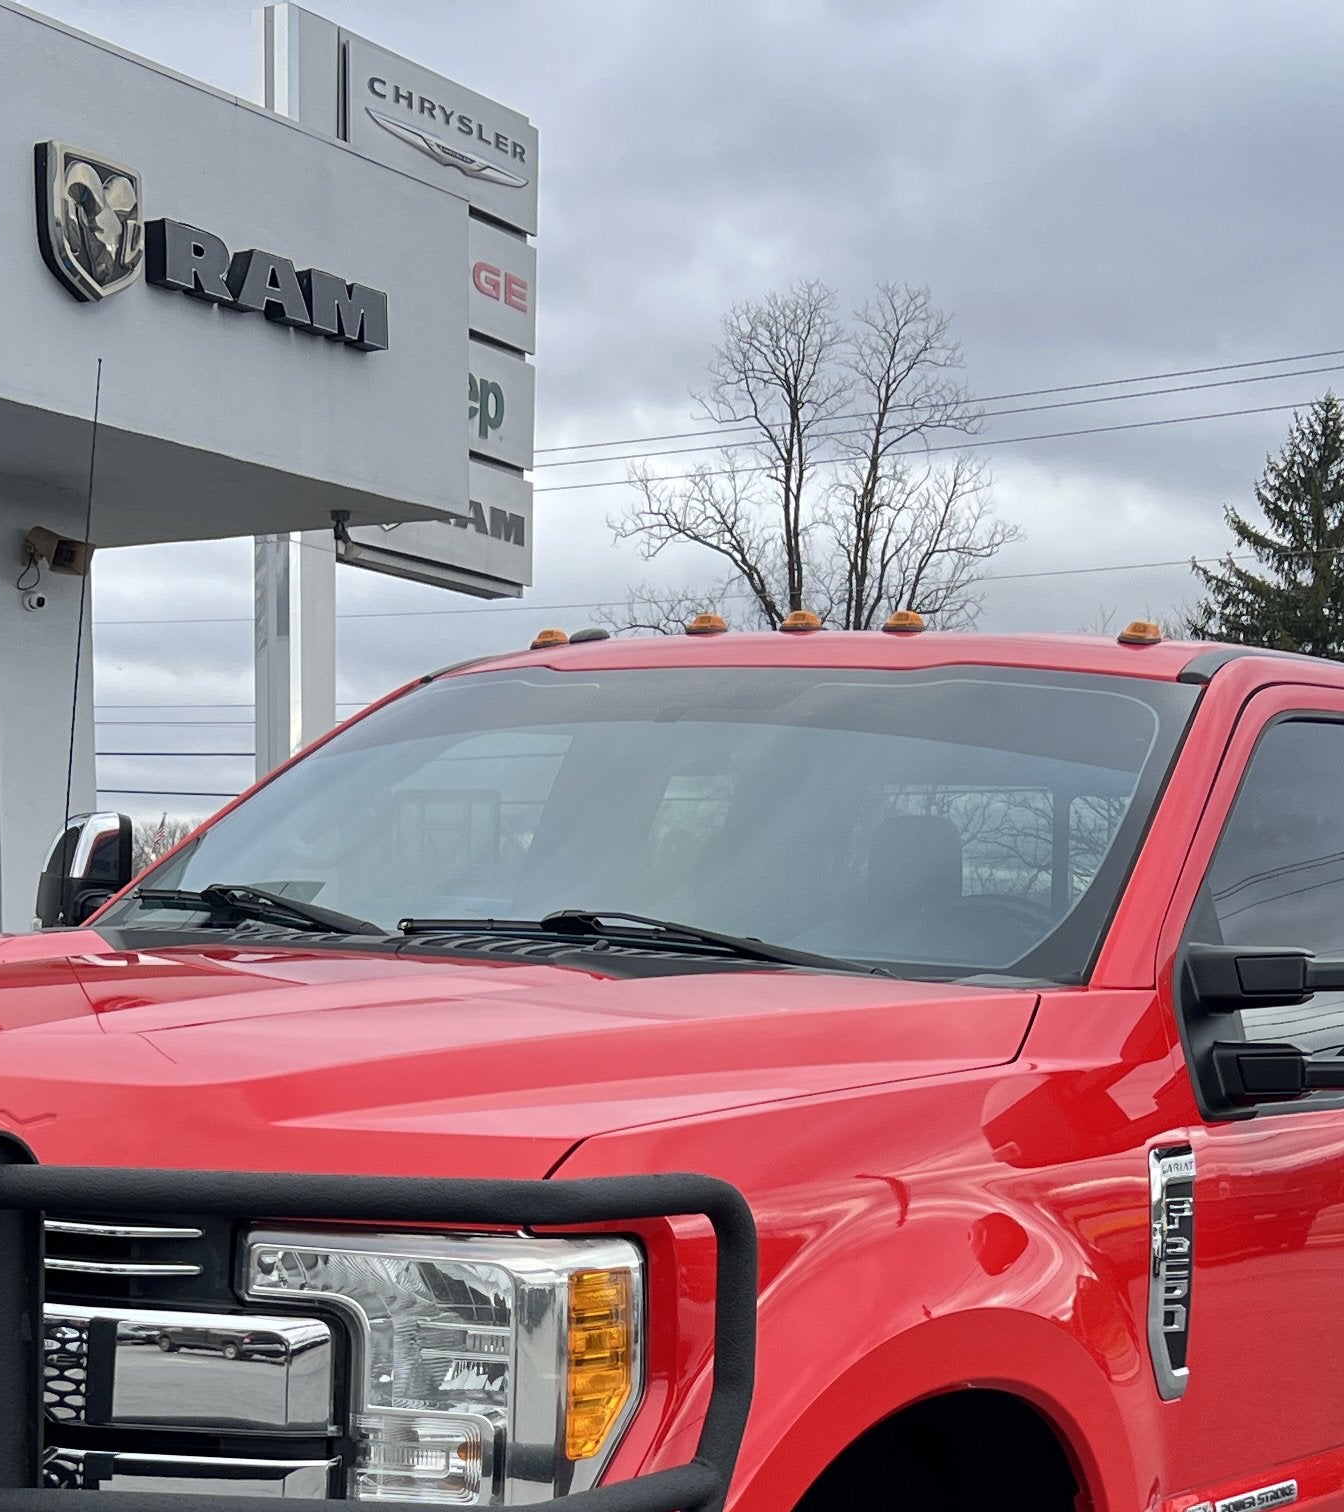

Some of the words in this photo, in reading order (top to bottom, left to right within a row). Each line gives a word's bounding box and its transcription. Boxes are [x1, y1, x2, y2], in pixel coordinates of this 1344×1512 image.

[367, 76, 527, 164] CHRYSLER
[146, 218, 389, 351] RAM
[437, 500, 525, 547] AM
[1161, 1161, 1193, 1175] LARIAT
[1256, 1483, 1296, 1506] STROKE
